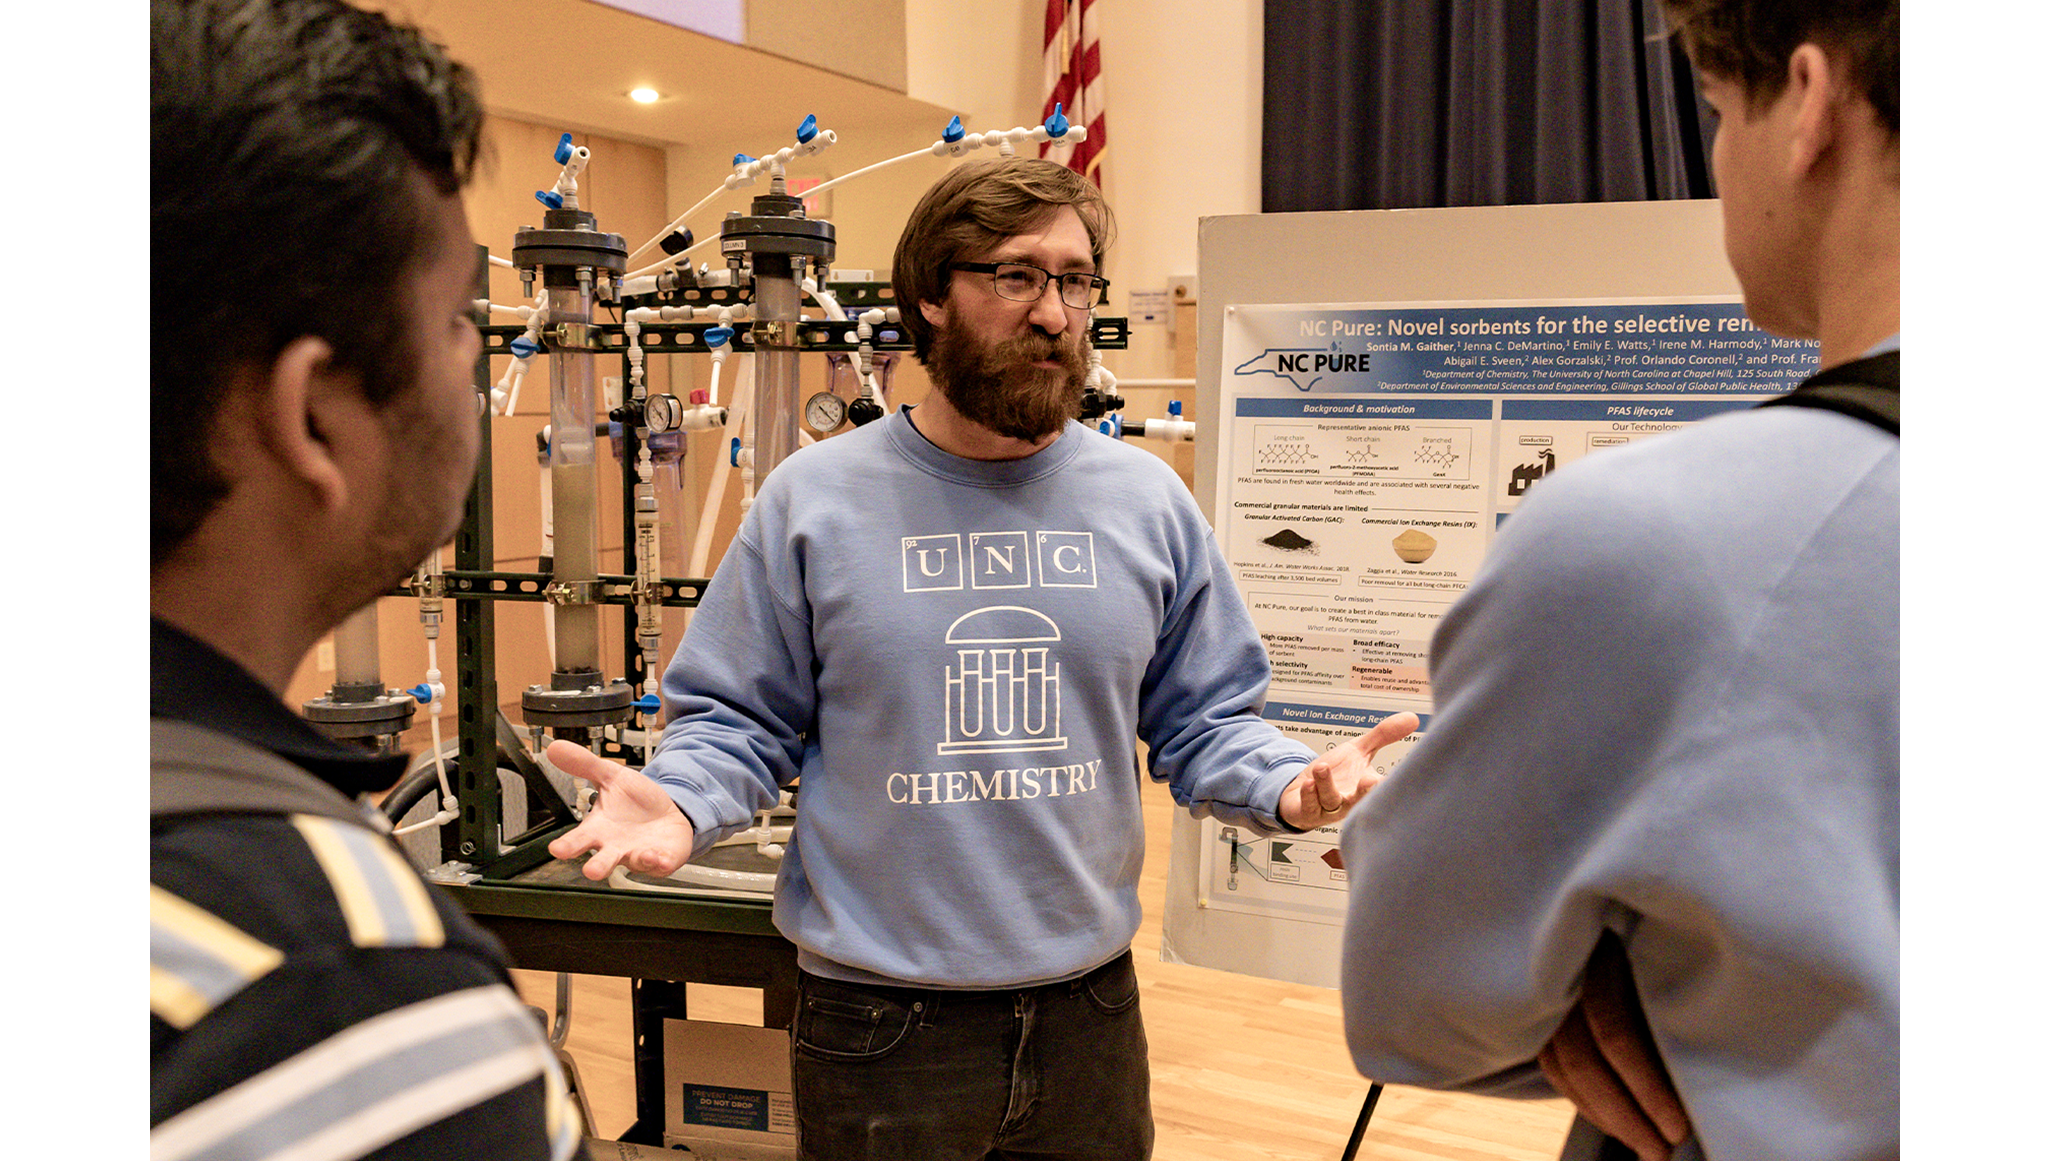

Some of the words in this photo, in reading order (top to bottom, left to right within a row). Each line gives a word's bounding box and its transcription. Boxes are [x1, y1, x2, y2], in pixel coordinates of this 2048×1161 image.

[1300, 320, 1326, 337] NC
[1332, 320, 1382, 336] Pure:
[1388, 318, 1444, 336] Novel
[1450, 318, 1531, 336] sorbents
[1537, 316, 1566, 334] for
[1572, 315, 1608, 334] the
[1614, 314, 1710, 334] selective
[1366, 342, 1398, 352] Sontia
[1400, 342, 1414, 352] M.
[1463, 341, 1492, 351] Jenna
[1494, 341, 1504, 351] C.
[1573, 340, 1602, 352] Emily
[1604, 340, 1614, 350] E.
[1659, 340, 1688, 350] Irene
[1690, 340, 1705, 350] M.
[1771, 338, 1802, 348] Mark
[1278, 354, 1309, 373] NC
[1314, 354, 1370, 372] PURE
[1444, 356, 1478, 368] Abigail
[1480, 356, 1489, 366] E.
[1532, 356, 1554, 366] Alex
[1614, 355, 1638, 365] Prof.
[1641, 354, 1686, 365] Orlando
[1746, 354, 1768, 364] and
[1771, 354, 1797, 364] Prof.
[1476, 370, 1484, 380] of
[1486, 370, 1530, 380] Chemistry,
[1532, 370, 1548, 378] The
[1549, 370, 1592, 380] University
[1594, 370, 1604, 380] of
[1604, 370, 1630, 378] North
[1632, 370, 1670, 378] Carolina
[1671, 370, 1682, 378] at
[1683, 370, 1716, 380] Chapel
[1716, 369, 1734, 379] Hill,
[1736, 369, 1754, 378] 125
[1756, 368, 1784, 378] South
[1430, 382, 1439, 392] of
[1440, 382, 1500, 391] Environmental
[1500, 382, 1536, 391] Sciences
[1537, 382, 1554, 390] and
[1556, 382, 1608, 392] Engineering,
[1611, 382, 1644, 392] Gillings
[1645, 382, 1675, 391] School
[1676, 382, 1686, 392] of
[1688, 382, 1718, 391] Global
[1720, 382, 1748, 391] Public
[1749, 382, 1783, 392] Health,
[1786, 382, 1800, 391] 13
[1304, 404, 1356, 414] Background
[1356, 405, 1364, 413] &
[1366, 406, 1416, 414] motivation
[1606, 406, 1632, 416] PFAS
[1634, 406, 1674, 416] lifecycle
[1612, 422, 1628, 430] Our
[1234, 501, 1272, 509] Commercial
[1412, 520, 1442, 528] Exchange
[973, 536, 980, 546] 7
[1040, 534, 1047, 543] 6
[906, 540, 918, 549] 92
[917, 548, 948, 577] U
[984, 546, 1016, 574] N
[1374, 640, 1400, 649] efficacy
[1276, 661, 1308, 669] selectivity
[1352, 666, 1393, 674] Regenerable
[1282, 708, 1308, 718] Novel
[1309, 710, 1322, 719] Ion
[1324, 711, 1366, 723] Exchange
[1300, 727, 1334, 736] advantage
[886, 758, 1102, 804] CHEMISTRY
[692, 1090, 726, 1100] PREVENT
[728, 1094, 761, 1102] DAMAGE
